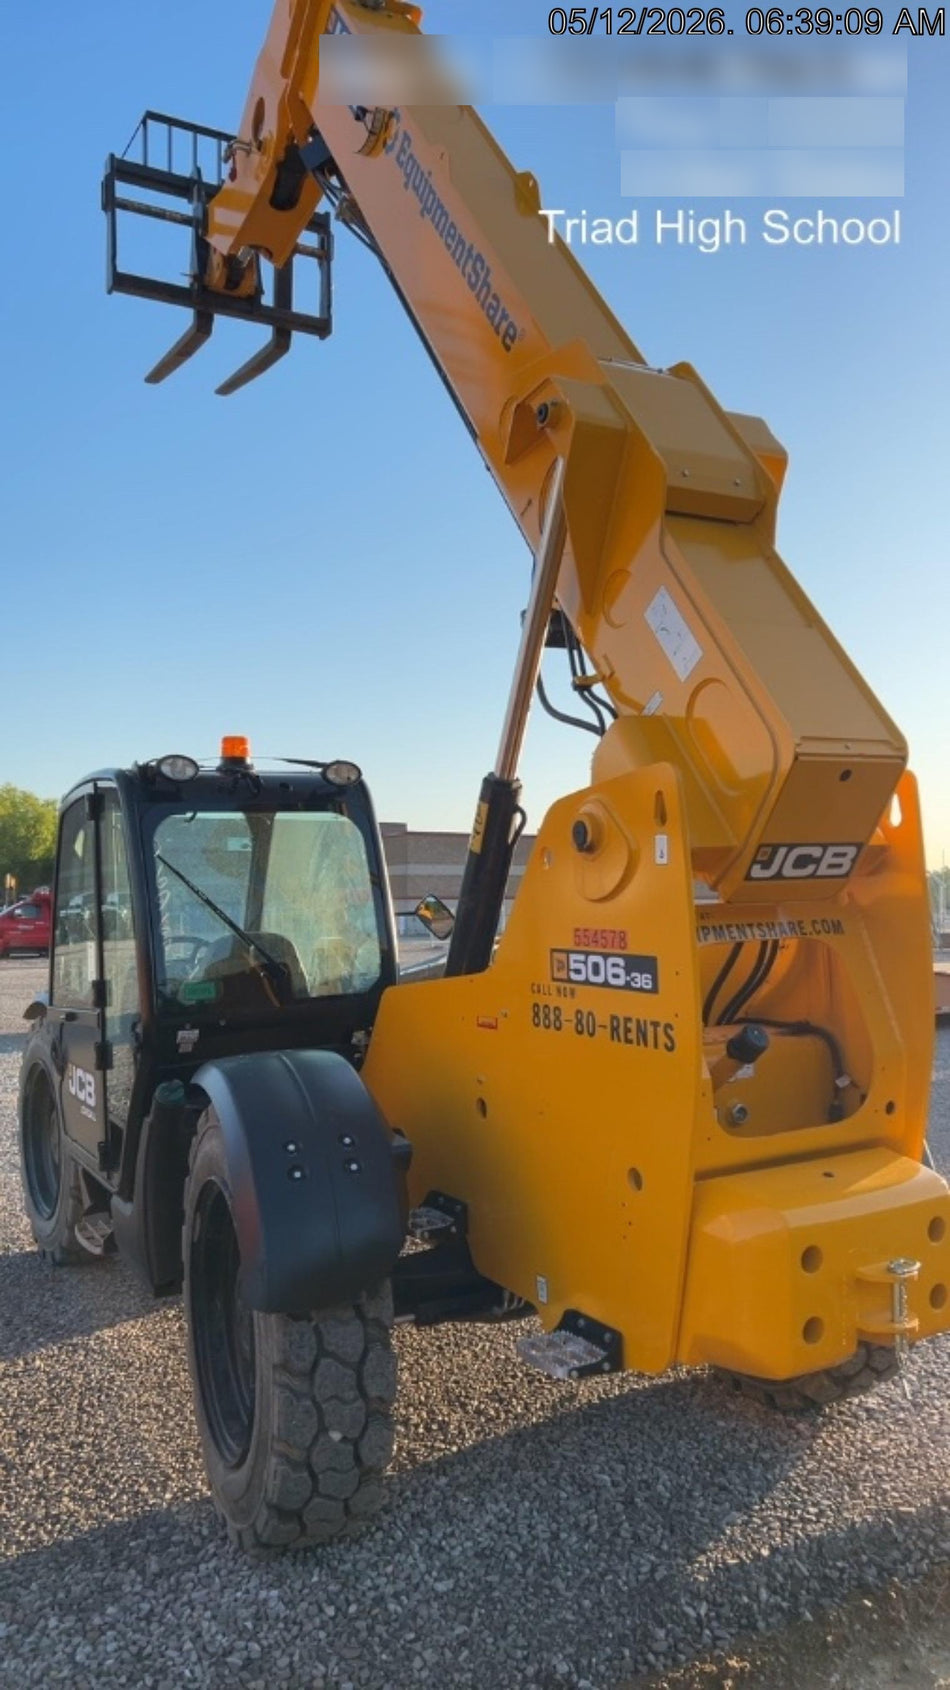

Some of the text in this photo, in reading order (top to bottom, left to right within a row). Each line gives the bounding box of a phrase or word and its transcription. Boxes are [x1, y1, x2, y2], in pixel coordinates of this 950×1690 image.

[395, 130, 518, 352] EquipmentShare
[750, 846, 858, 878] JCB
[573, 927, 628, 950] 554578
[531, 982, 576, 999] CALL NOW
[532, 1002, 676, 1052] 888-80-RENTS
[68, 1065, 97, 1107] JCB
